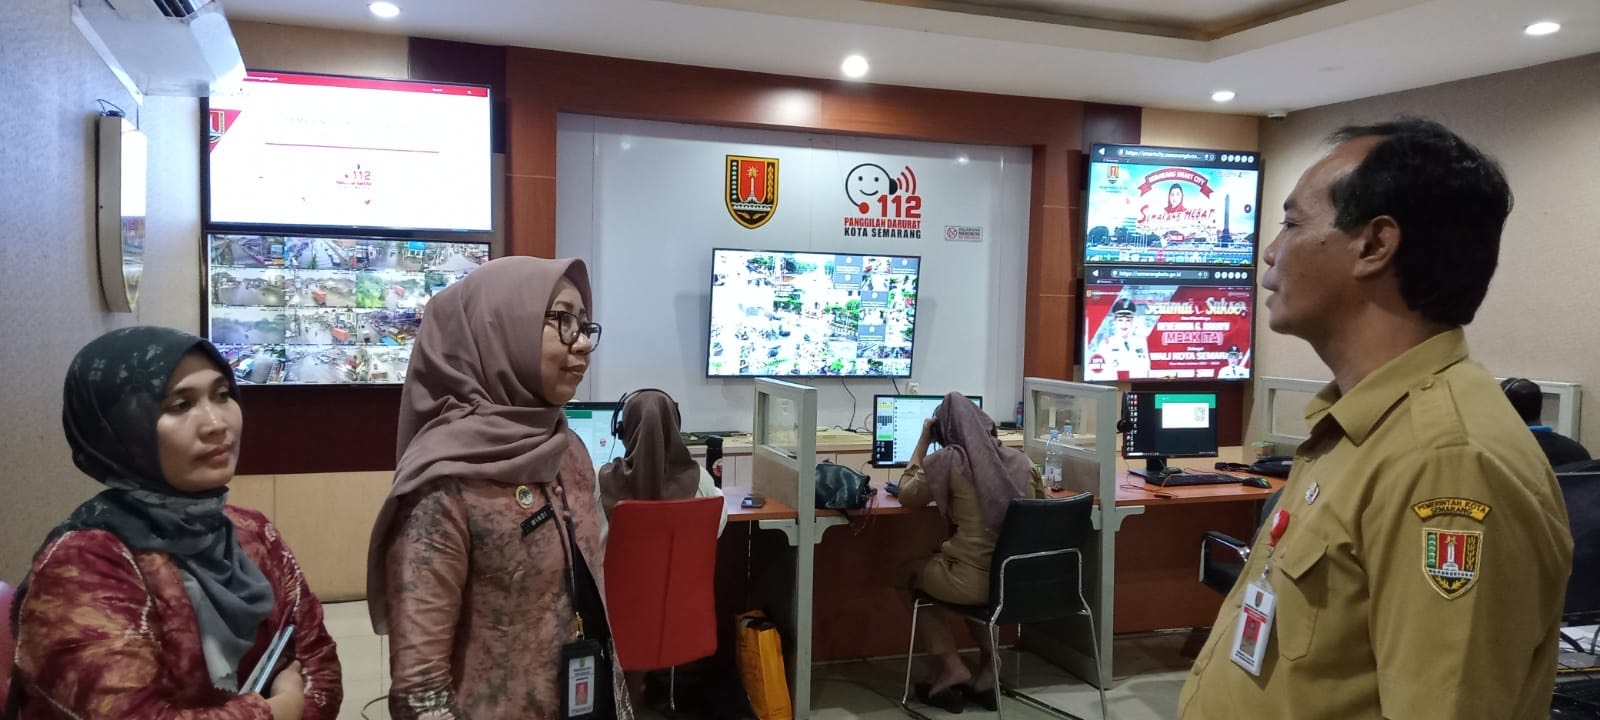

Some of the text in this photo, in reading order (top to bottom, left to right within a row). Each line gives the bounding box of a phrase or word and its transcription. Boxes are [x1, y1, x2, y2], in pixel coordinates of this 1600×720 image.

[353, 170, 371, 180] 112
[1193, 175, 1206, 186] CITY
[877, 194, 921, 218] 112
[844, 217, 921, 230] PANGGILAN DARURAT
[844, 227, 921, 239] KOTA SEMARANG
[1417, 499, 1486, 513] PEMERINTAH KOTA
[1431, 507, 1473, 515] SEMARANG
